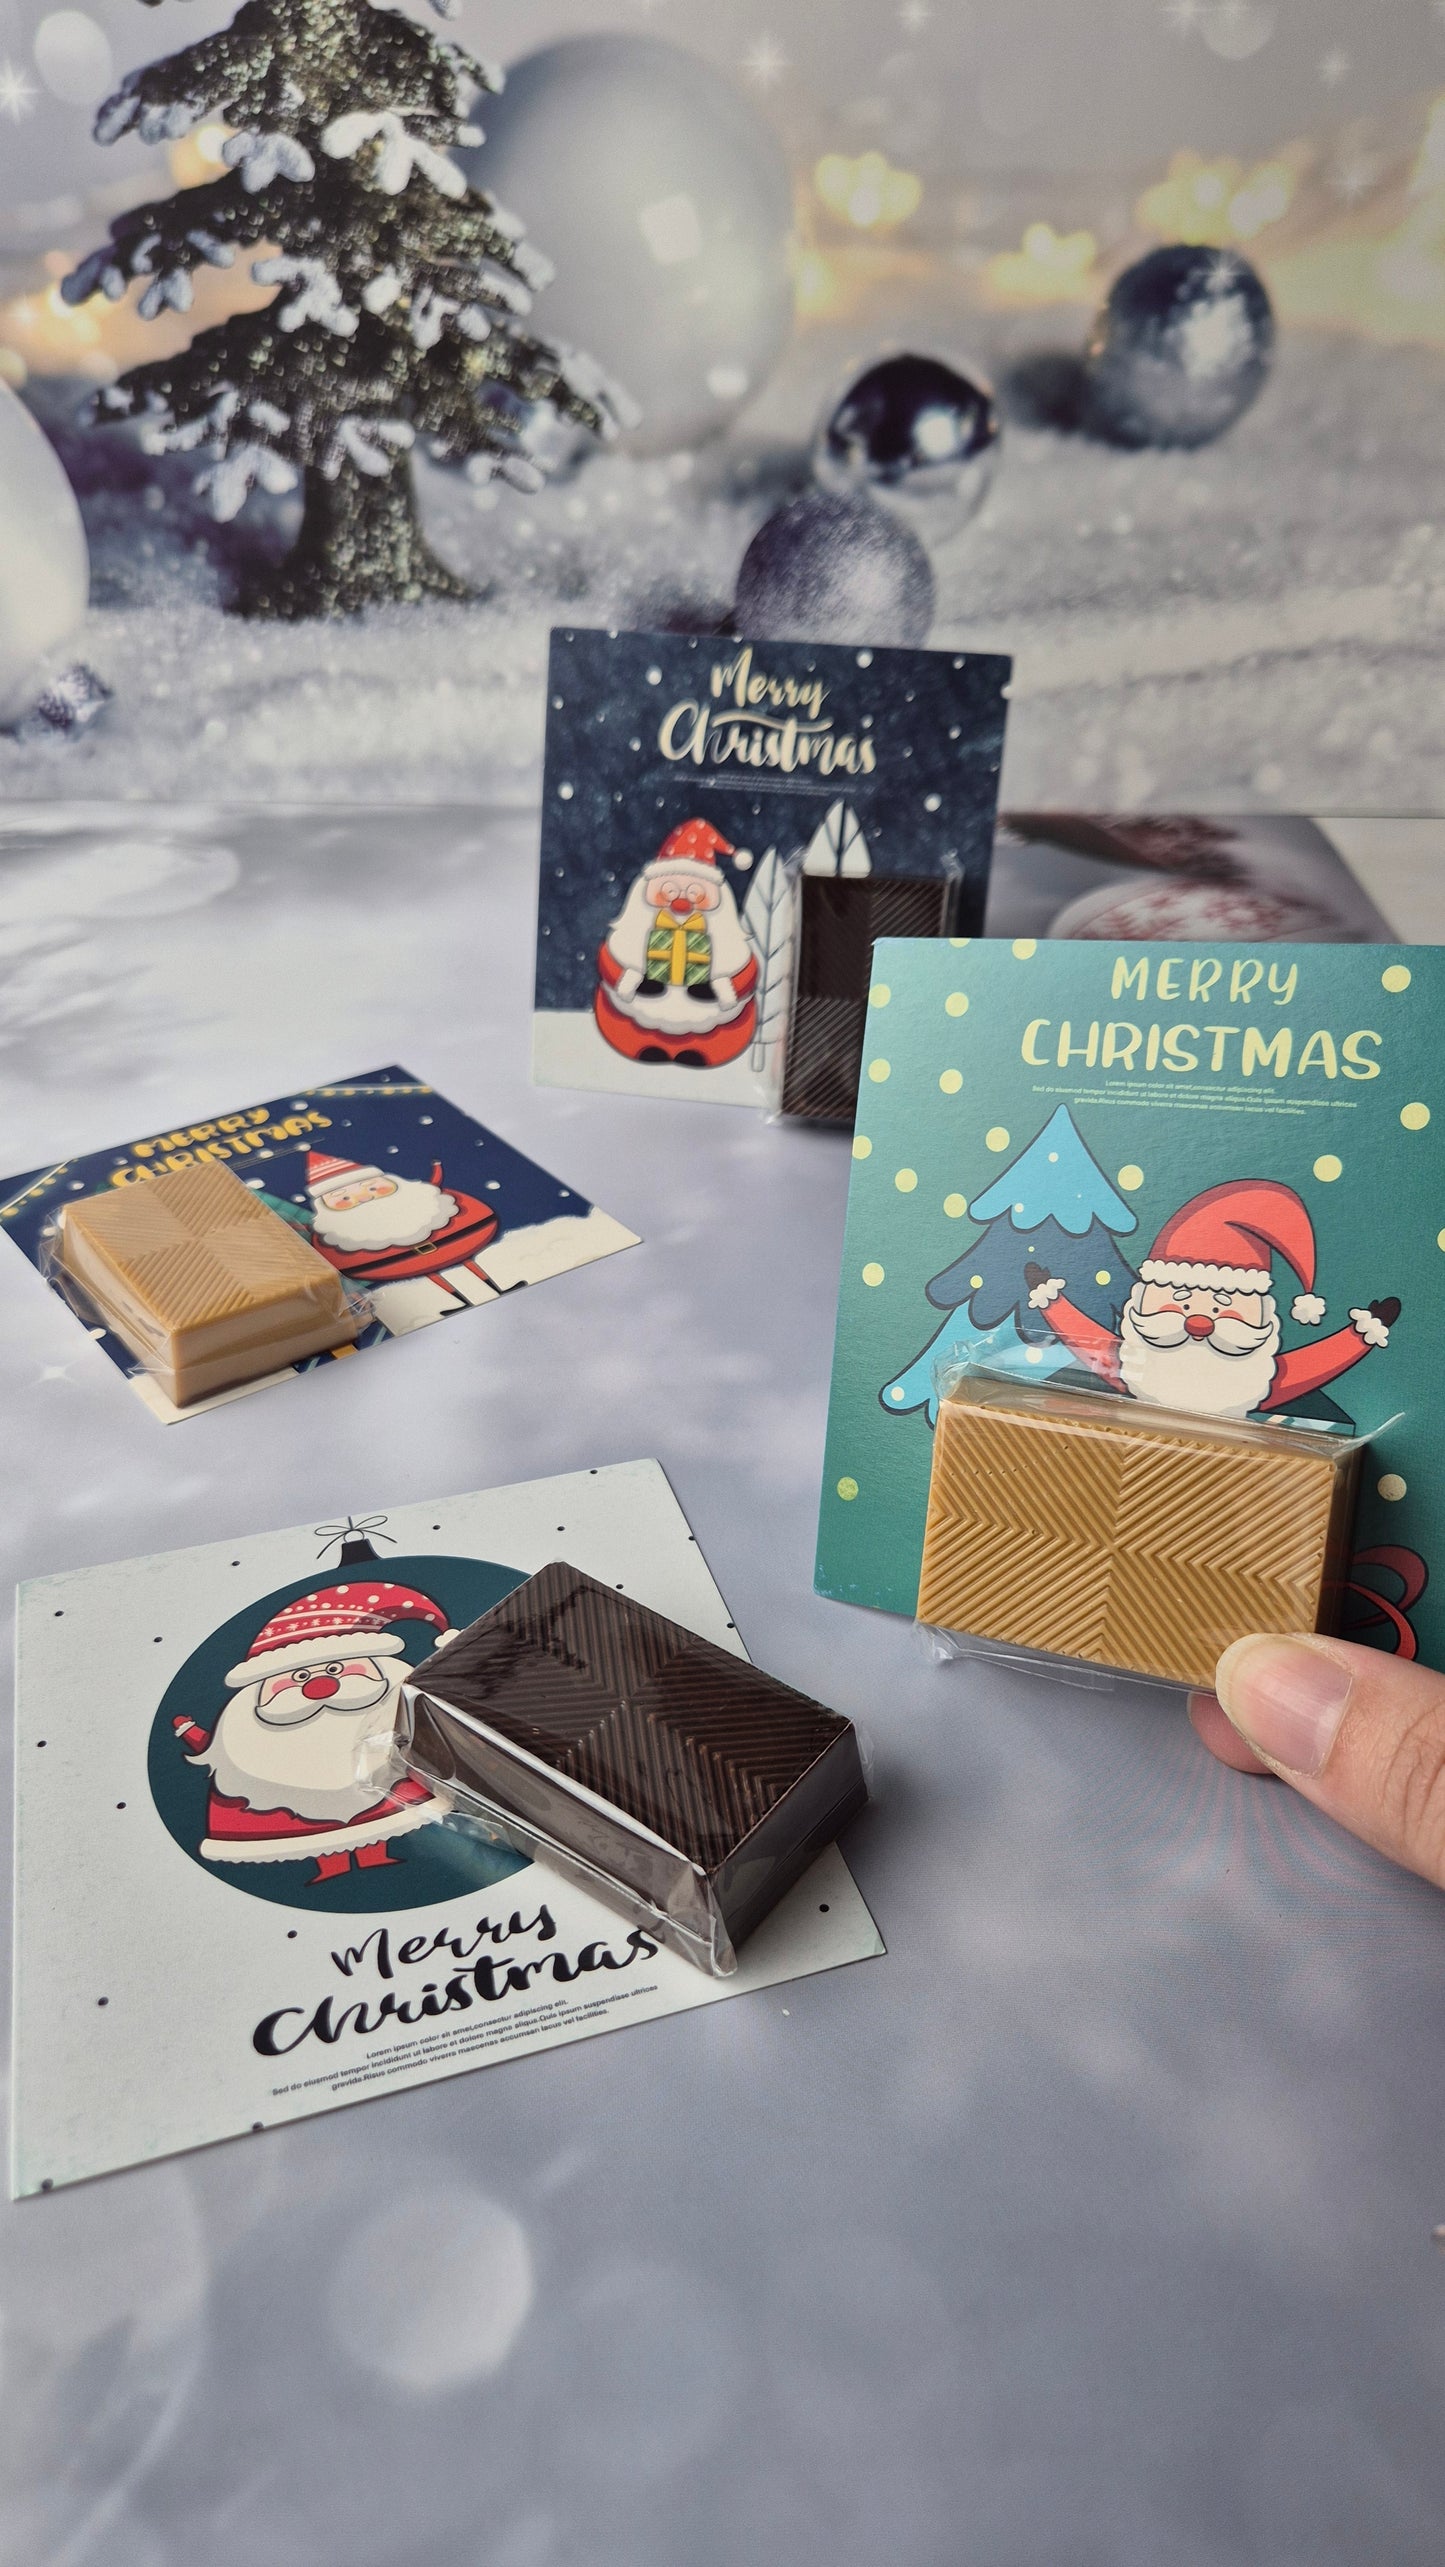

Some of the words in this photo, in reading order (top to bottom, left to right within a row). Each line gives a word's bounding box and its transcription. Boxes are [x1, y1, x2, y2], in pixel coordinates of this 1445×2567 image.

[710, 646, 831, 719] Merry
[658, 698, 876, 775] Christmas
[1111, 956, 1298, 1006] MERRY
[1021, 1018, 1382, 1080] CHRISTMAS
[110, 1110, 332, 1188] CHRISTMAS
[133, 1107, 270, 1158] MERRY
[331, 1904, 558, 1980] Merry
[252, 1927, 659, 2056] Christmas
[272, 2086, 289, 2096] Sed
[304, 2071, 339, 2087] eiusmod
[340, 2064, 370, 2077] tempor
[371, 2051, 412, 2068] incididunt
[413, 2049, 422, 2057] ut
[422, 2043, 448, 2054] labore
[459, 2033, 484, 2044] dolore
[486, 2024, 512, 2037] magna
[558, 2006, 582, 2017] ipsum
[366, 2046, 392, 2060] Lorem
[393, 2040, 418, 2053] ipsum
[441, 2031, 451, 2039] sit
[514, 2003, 553, 2019] adipiscing
[387, 2058, 428, 2075] commodo
[429, 2050, 457, 2062] viverra
[563, 2017, 574, 2025] vel
